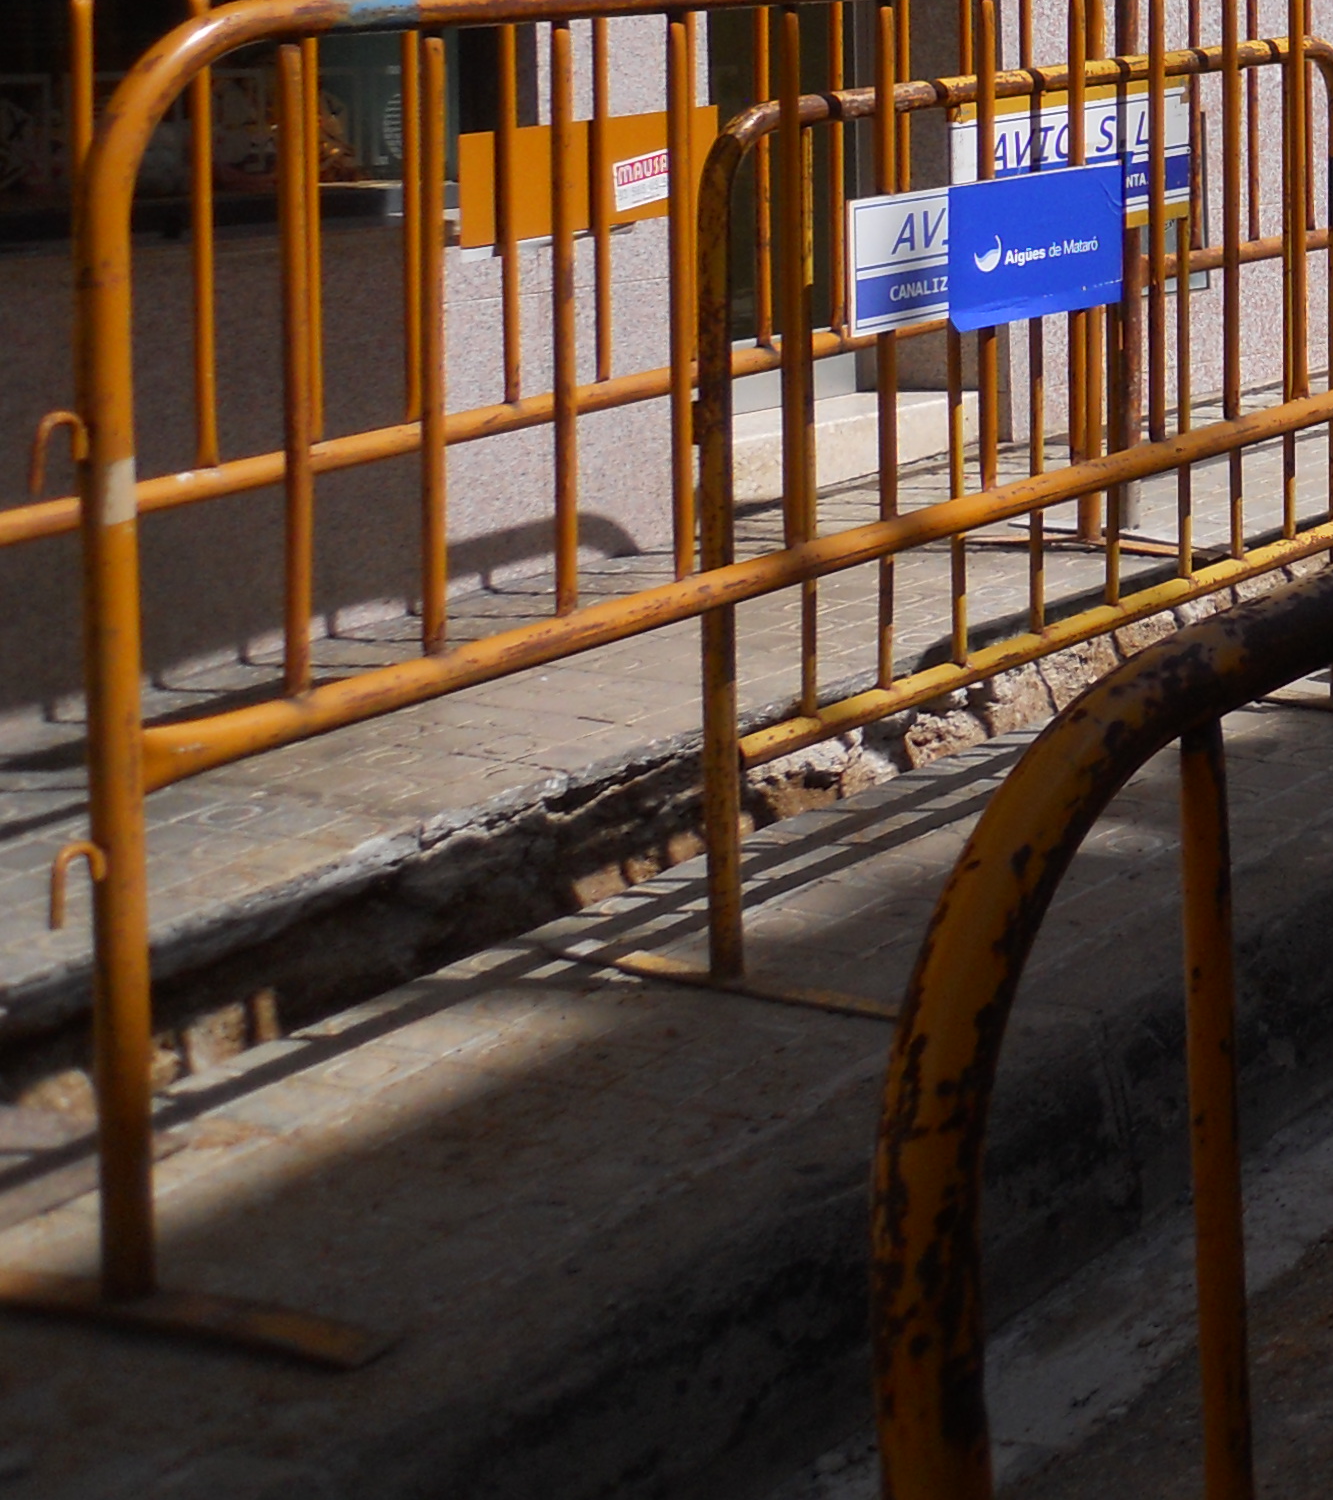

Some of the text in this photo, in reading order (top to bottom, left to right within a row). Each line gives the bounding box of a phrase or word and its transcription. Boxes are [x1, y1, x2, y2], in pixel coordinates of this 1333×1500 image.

[891, 206, 948, 255] AV
[1004, 235, 1099, 267] Aigües de Mataró
